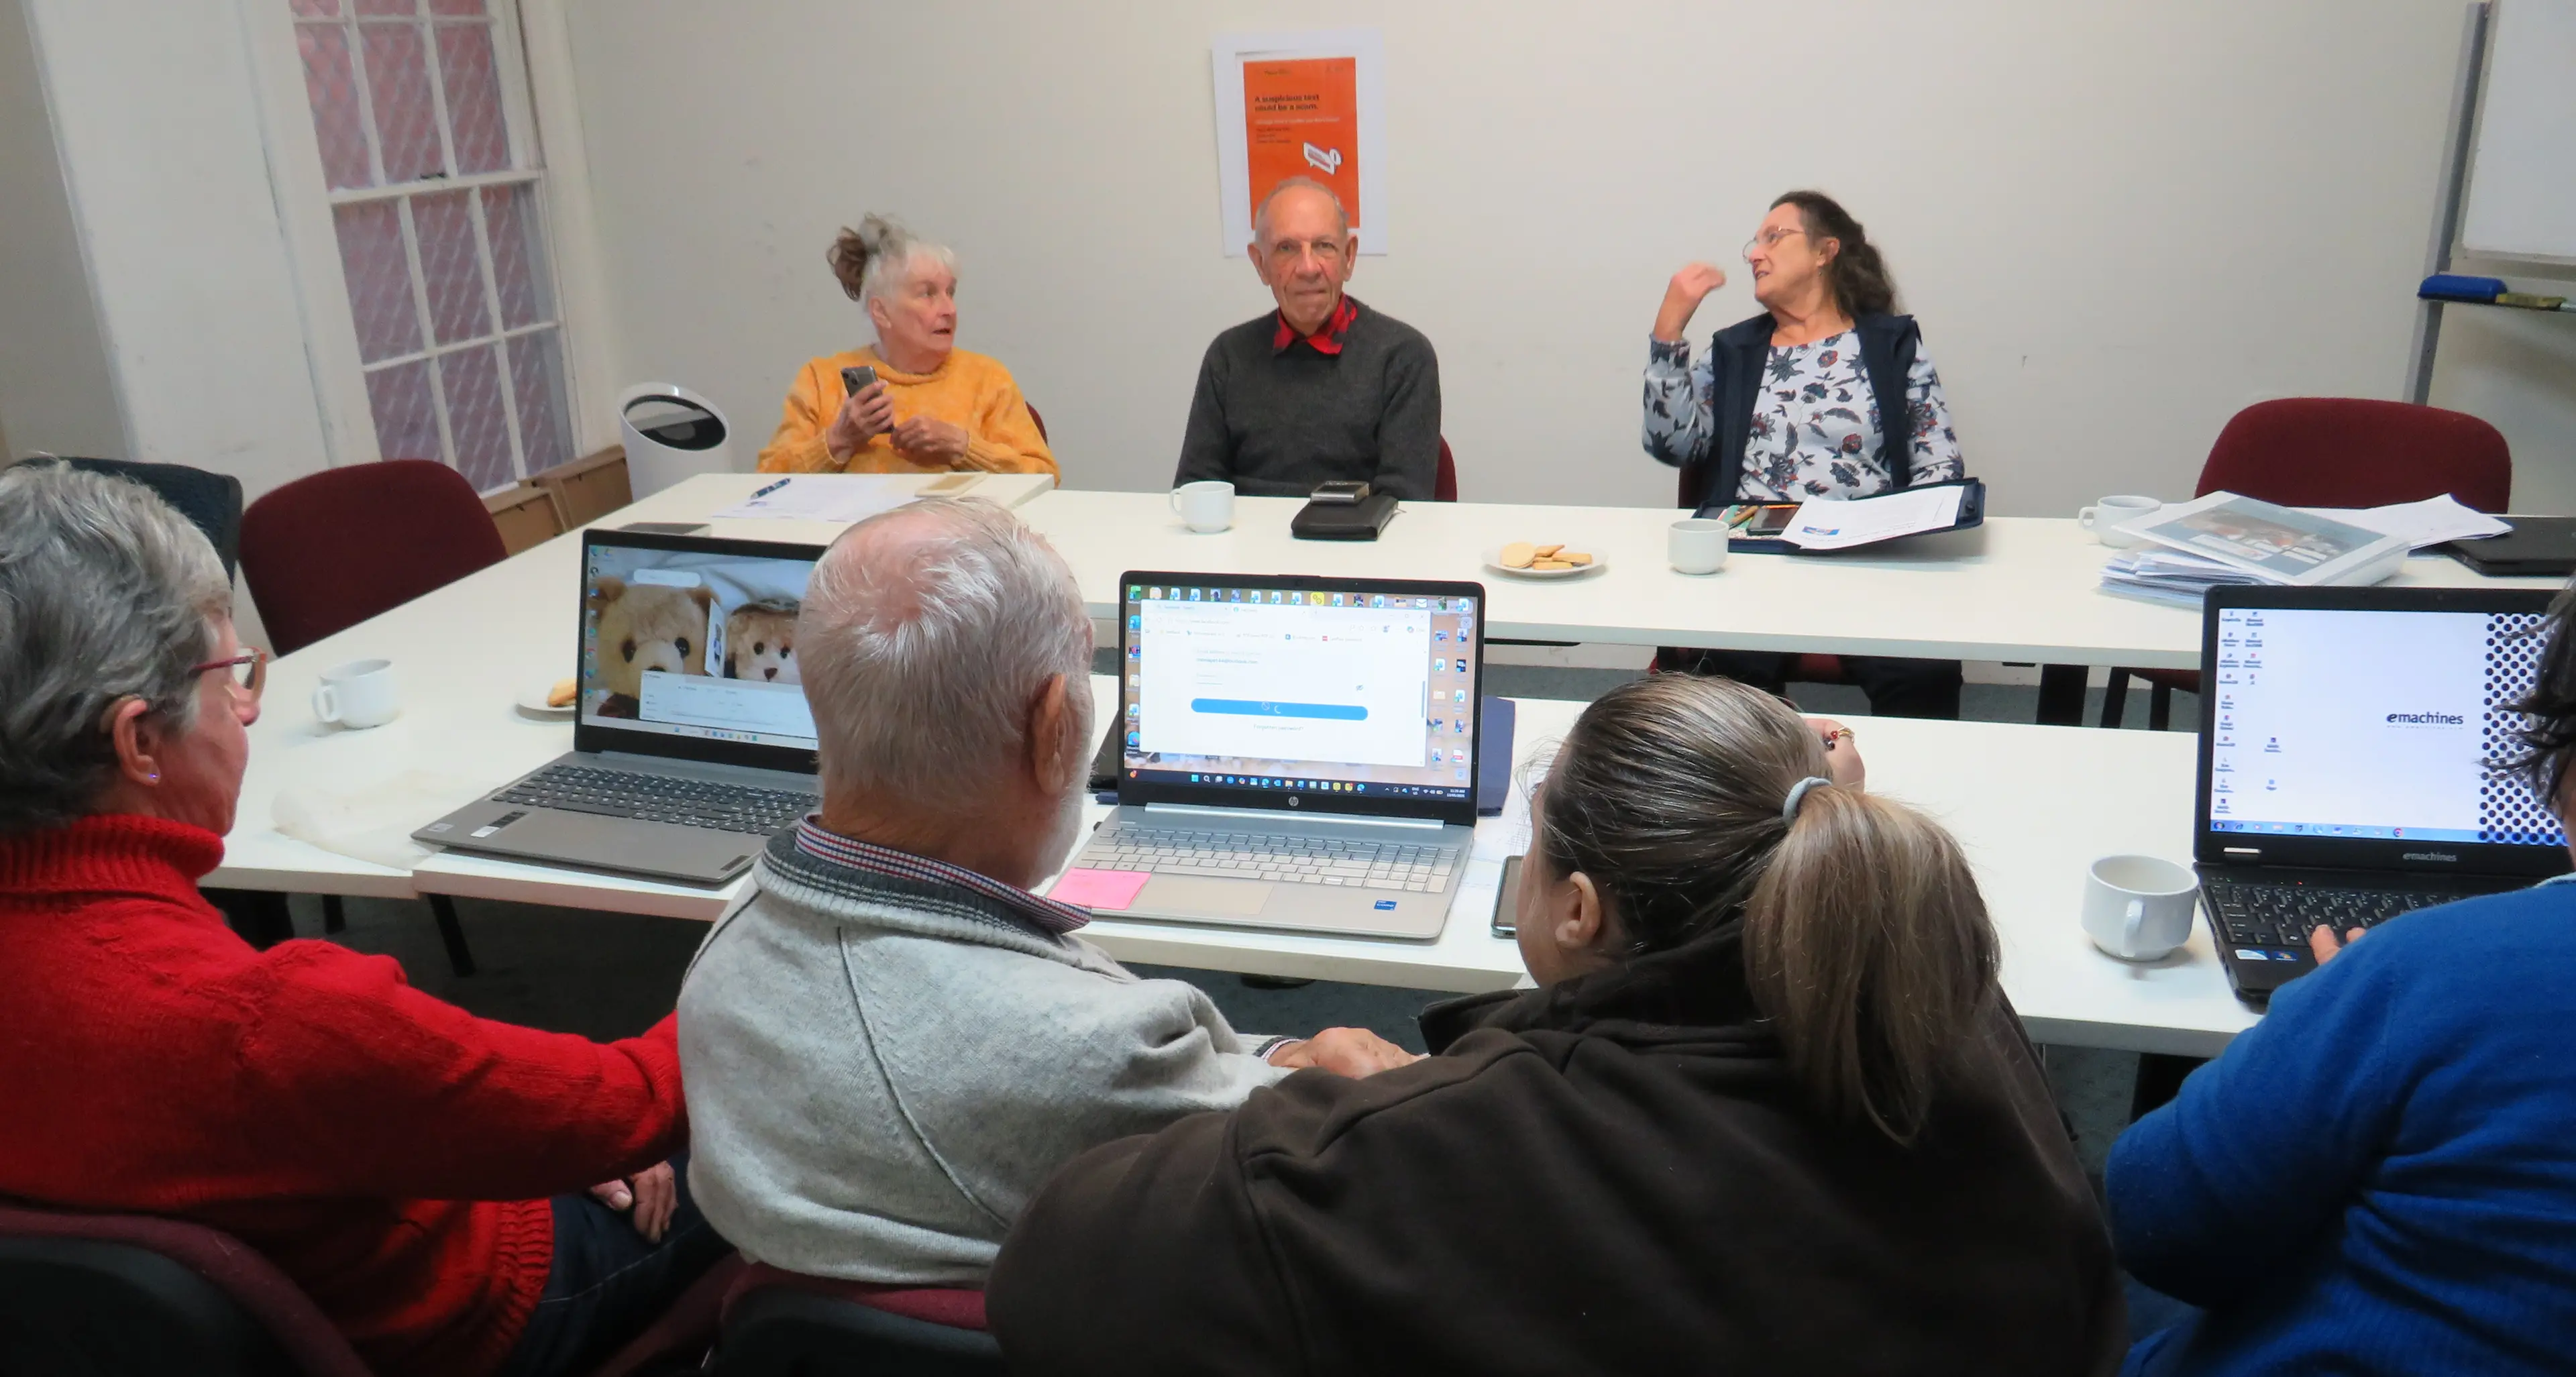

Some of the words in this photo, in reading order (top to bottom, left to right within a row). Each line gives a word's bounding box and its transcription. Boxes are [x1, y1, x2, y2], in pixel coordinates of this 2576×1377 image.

[1262, 95, 1302, 103] suspicious
[2386, 712, 2464, 724] emachines
[2402, 852, 2457, 862] emachines
